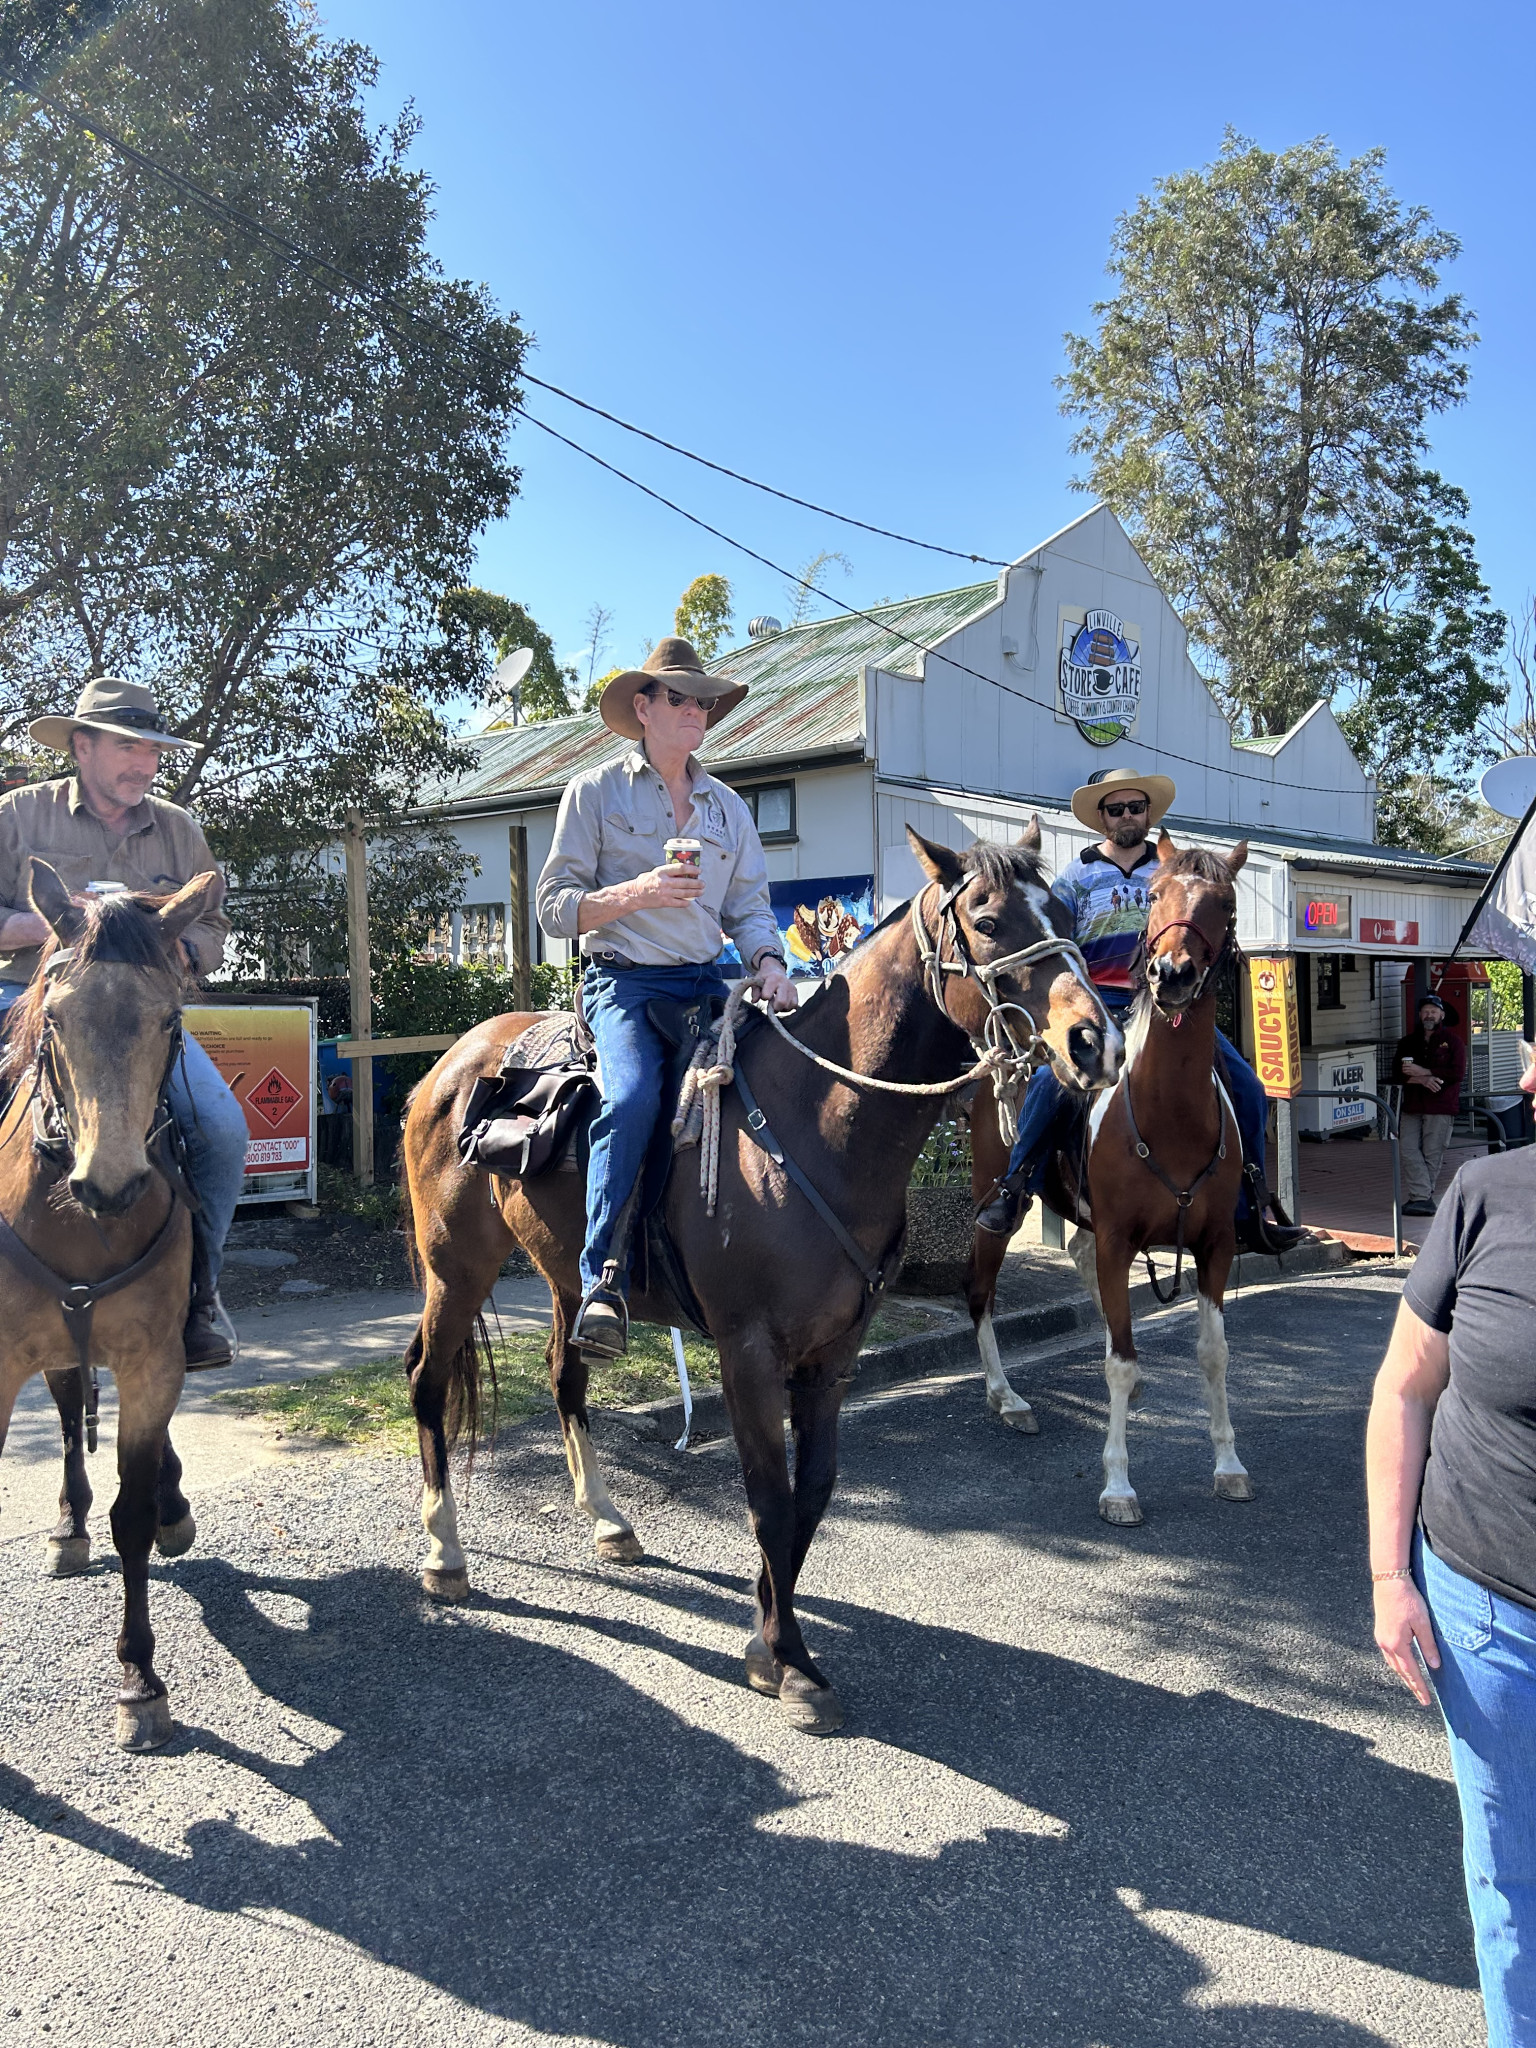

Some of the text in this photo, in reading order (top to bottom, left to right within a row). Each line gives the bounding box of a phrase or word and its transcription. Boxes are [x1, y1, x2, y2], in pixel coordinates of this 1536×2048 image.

[1088, 611, 1122, 637] LINVILLE
[1061, 660, 1141, 697] STORE CAFE
[1066, 696, 1080, 717] COFFEE
[1081, 701, 1102, 717] COMMUNITY
[1106, 699, 1122, 714] COUNTRY
[1308, 901, 1338, 925] OPEN
[1257, 1000, 1285, 1083] SAUCY
[1287, 1000, 1300, 1081] SAUCY
[1333, 1065, 1364, 1087] KLEER
[255, 1096, 284, 1104] FLAMMABLE
[1338, 1085, 1360, 1105] ICE
[272, 1107, 278, 1116] 2
[1335, 1104, 1363, 1118] ON SALE
[253, 1141, 282, 1152] CONTACT
[260, 1152, 270, 1162] 819
[271, 1151, 282, 1161] 783
